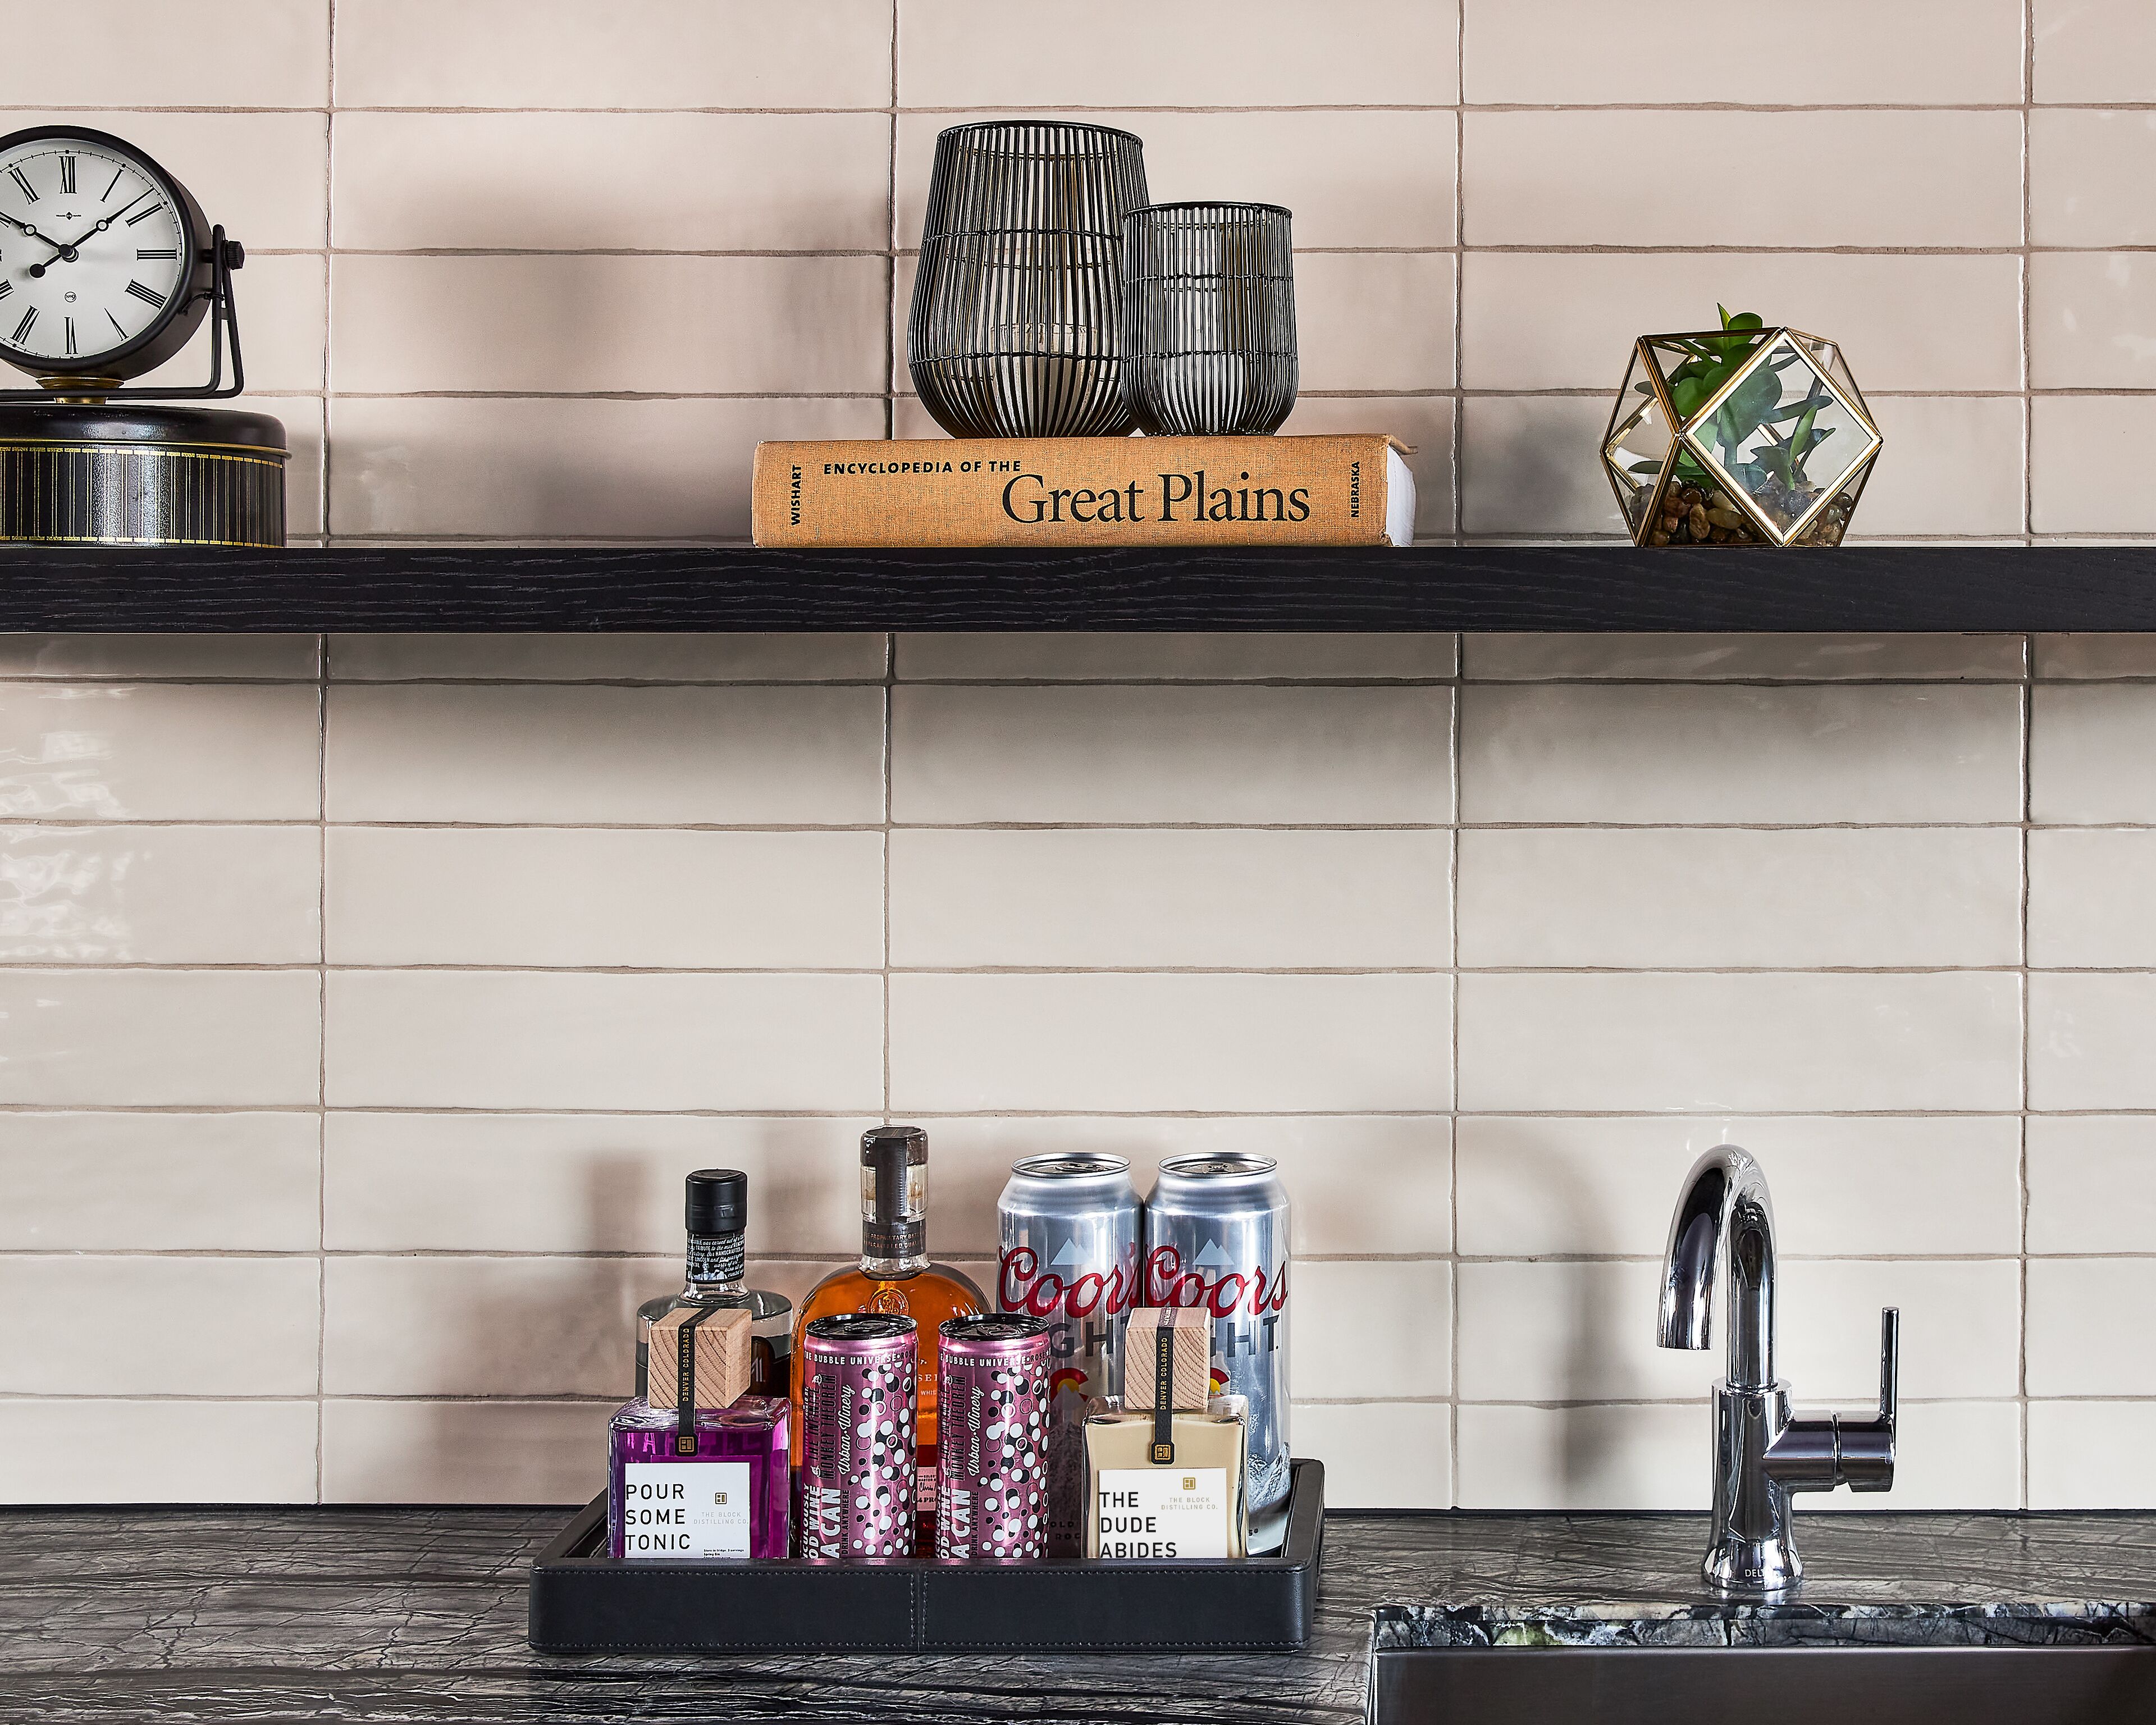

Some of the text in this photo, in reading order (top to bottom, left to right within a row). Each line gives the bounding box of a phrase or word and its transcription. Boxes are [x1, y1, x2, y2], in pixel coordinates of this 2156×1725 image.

[824, 460, 1021, 475] ENCYCLOPEDIA OF THE
[791, 464, 802, 526] WISHART
[1002, 470, 1310, 523] Great Plains
[1351, 460, 1360, 518] NEBRASKA
[715, 1247, 740, 1256] HANDCRAFTED
[999, 1245, 1143, 1318] Coors
[1146, 1243, 1288, 1317] Coors
[814, 1354, 846, 1365] BUBBLE
[945, 1354, 975, 1366] BUBBLE
[821, 1374, 836, 1480] MONKEY THEOREM
[951, 1375, 966, 1481] MONKEY THEOREM
[808, 1440, 820, 1461] THE
[625, 1484, 684, 1500] POUR
[809, 1485, 820, 1530] WINE
[941, 1486, 950, 1530] WINE
[1099, 1491, 1139, 1508] THE
[625, 1509, 686, 1525] SOME
[820, 1488, 841, 1559] A CAN
[951, 1489, 970, 1559] A CAN
[1100, 1517, 1157, 1533] DUDE
[625, 1534, 691, 1550] TONIC
[1100, 1542, 1177, 1558] ABIDES
